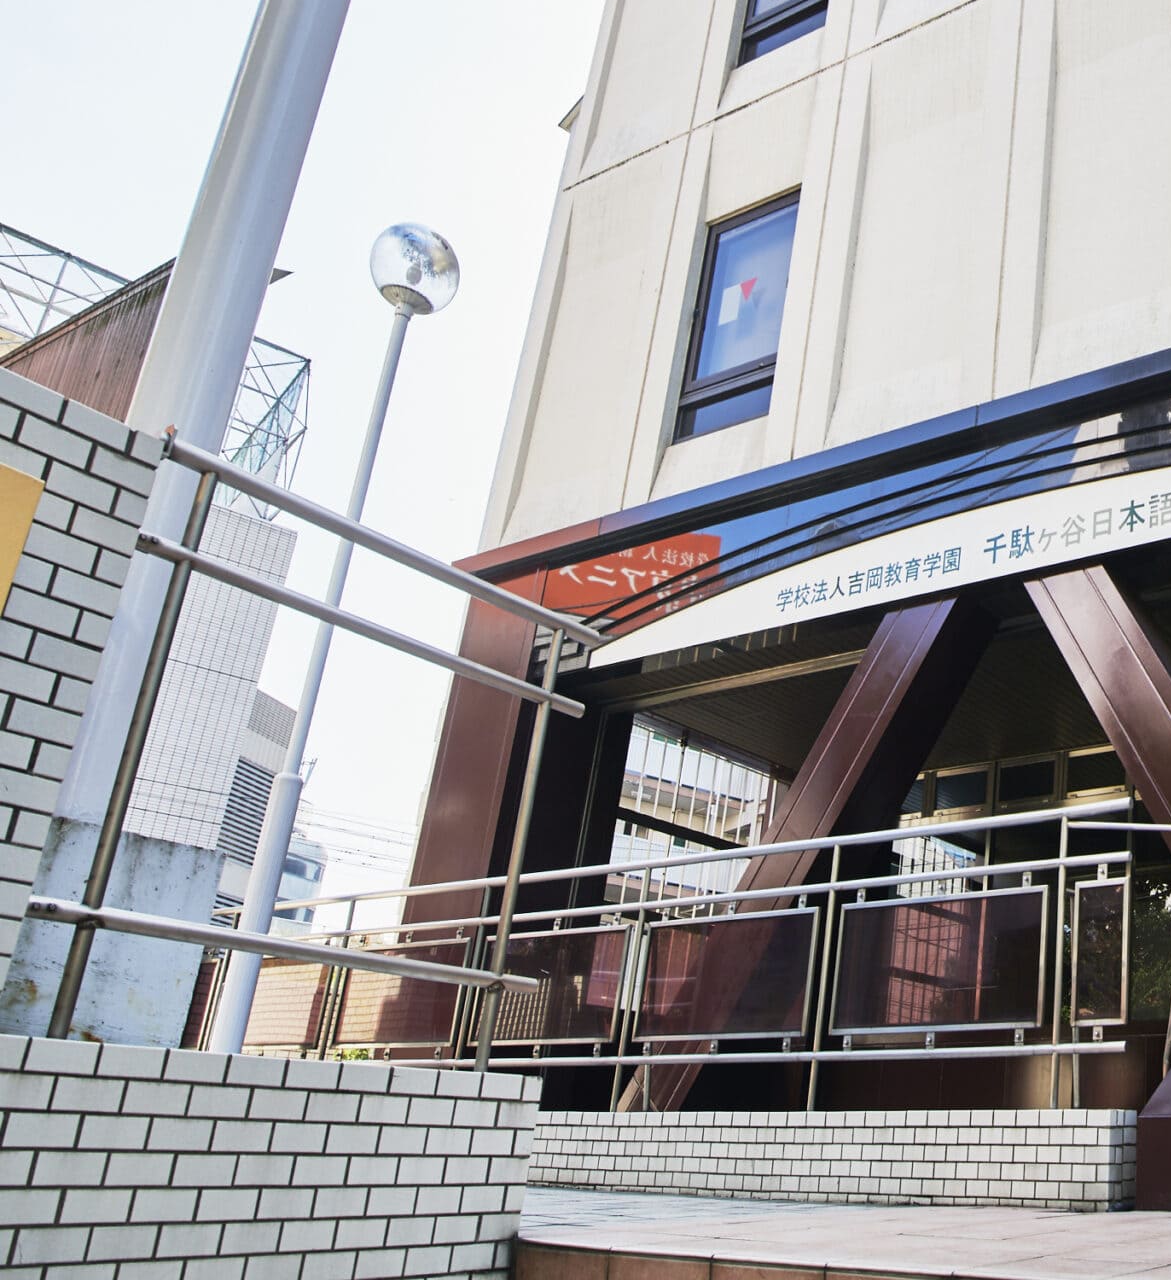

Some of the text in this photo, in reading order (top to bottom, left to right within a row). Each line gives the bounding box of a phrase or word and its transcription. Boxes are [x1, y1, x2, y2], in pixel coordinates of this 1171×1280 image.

[776, 547, 962, 612] 学校法人吉岡教育学園
